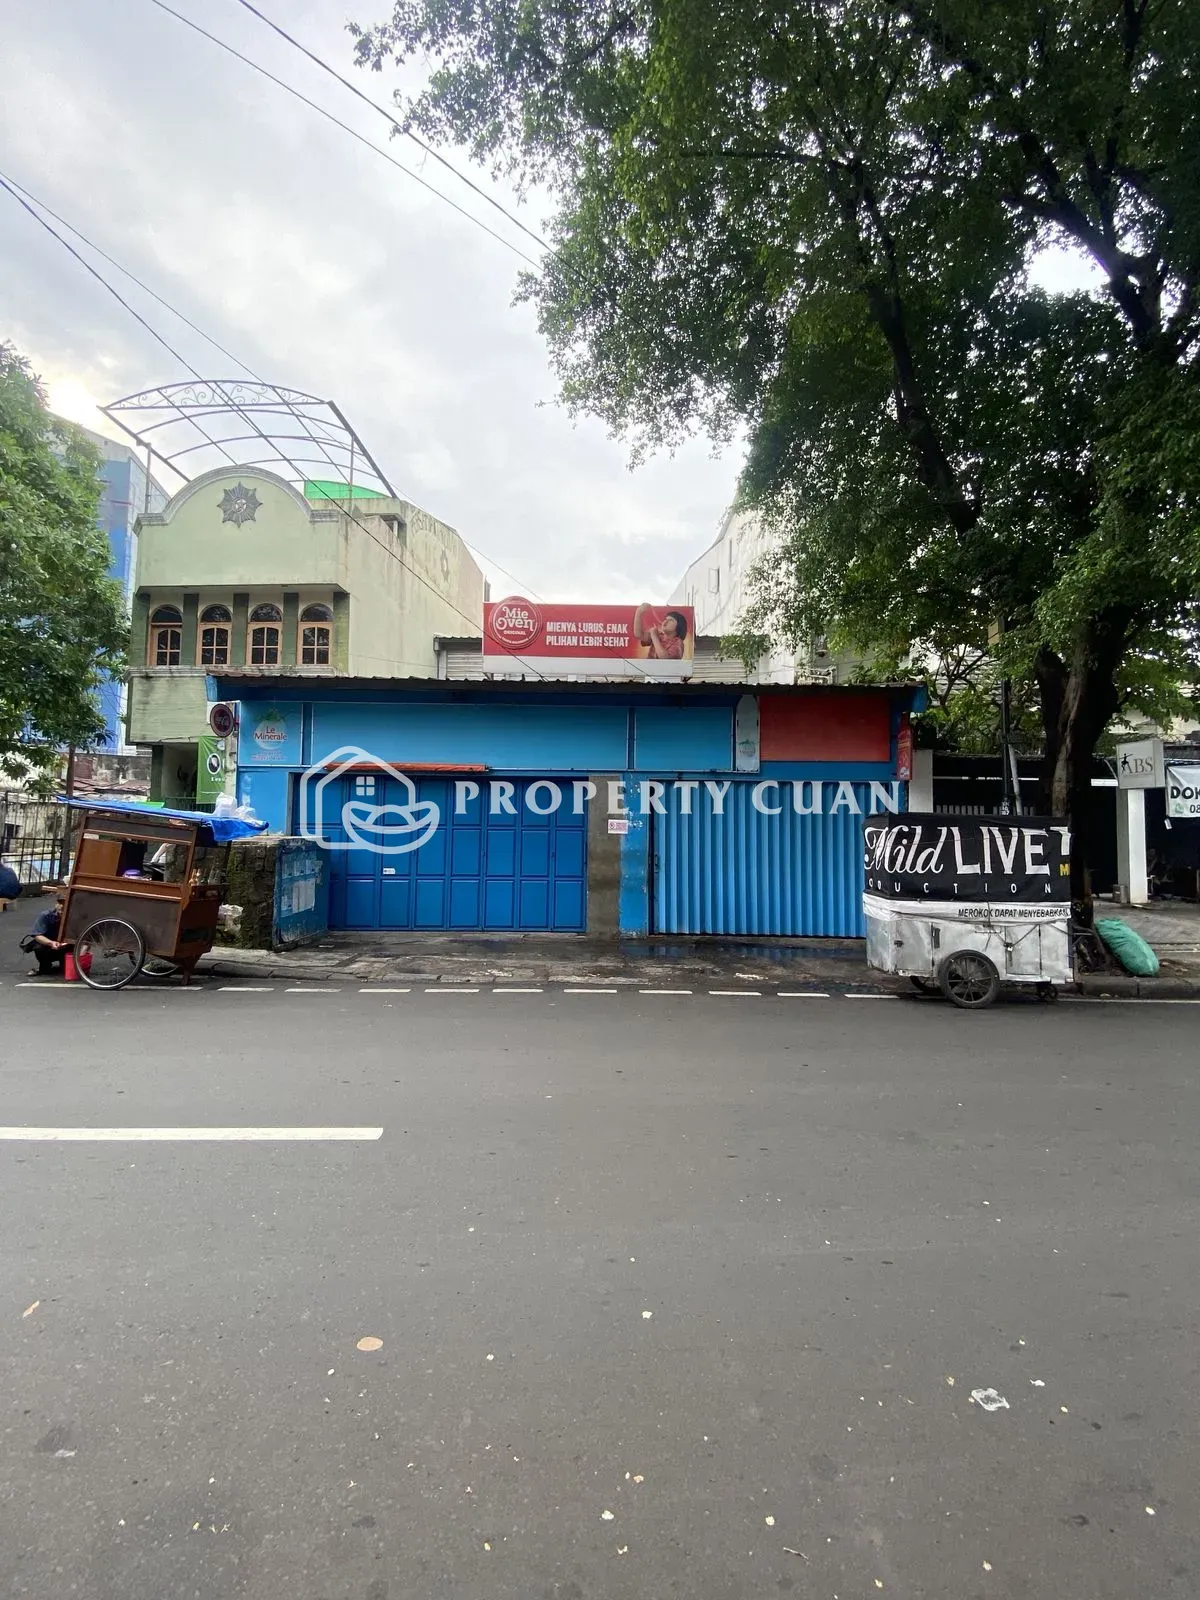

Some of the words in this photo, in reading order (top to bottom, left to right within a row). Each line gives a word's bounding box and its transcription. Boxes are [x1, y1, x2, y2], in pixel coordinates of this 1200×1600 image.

[502, 606, 529, 619] Mie
[495, 617, 536, 632] Oven
[546, 621, 577, 633] MIENYA
[606, 623, 628, 634] ENAK
[546, 635, 578, 646] PILIHAN
[580, 636, 603, 647] LEBIH
[603, 636, 630, 647] SEHAT
[266, 725, 275, 733] Le
[255, 732, 287, 740] Minerale
[864, 825, 948, 874] Mild
[950, 826, 1051, 876] LIVE
[958, 908, 994, 918] MEROKOK
[994, 909, 1018, 918] DAPAT
